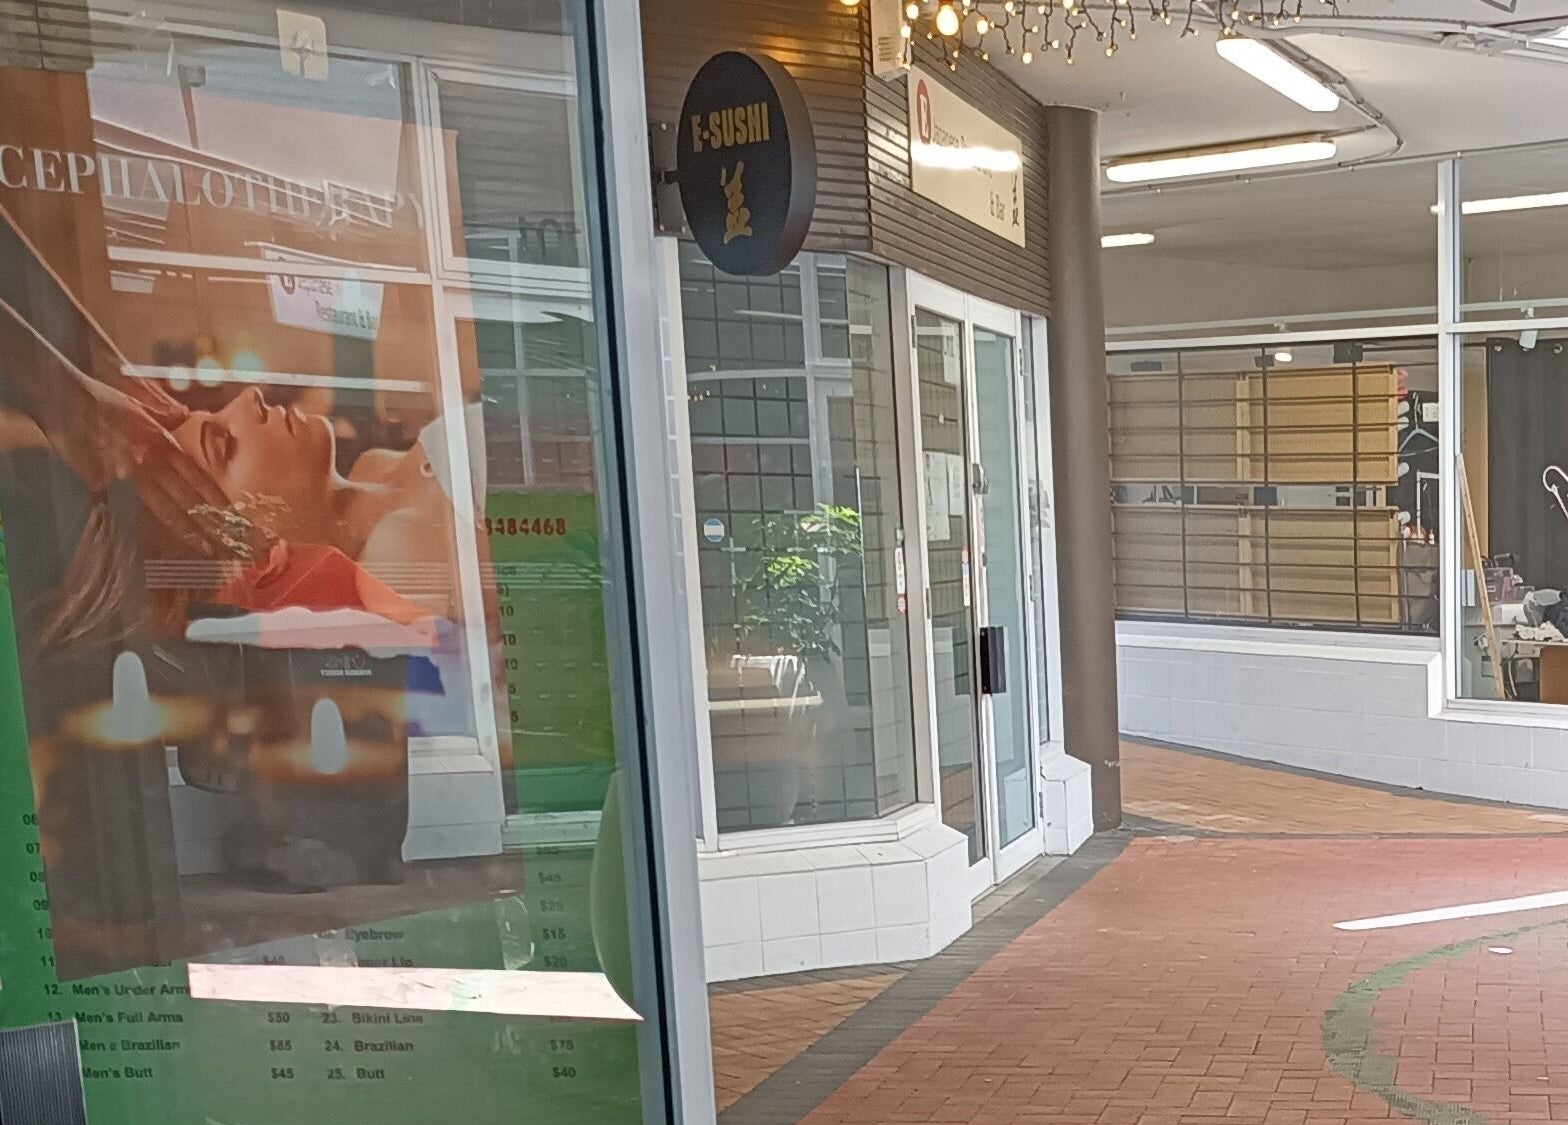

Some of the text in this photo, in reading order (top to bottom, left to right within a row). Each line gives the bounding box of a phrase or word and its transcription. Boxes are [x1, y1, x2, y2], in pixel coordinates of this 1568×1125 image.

[691, 102, 771, 152] E-SUSHI
[76, 1012, 290, 1024] Men's Full Arms $50
[352, 1012, 424, 1025] Bikini Line
[121, 1039, 181, 1051] Brazilian
[354, 1039, 414, 1052] Brazilian
[82, 1067, 294, 1080] Men's Butt $45
[356, 1066, 576, 1080] Butt $40
